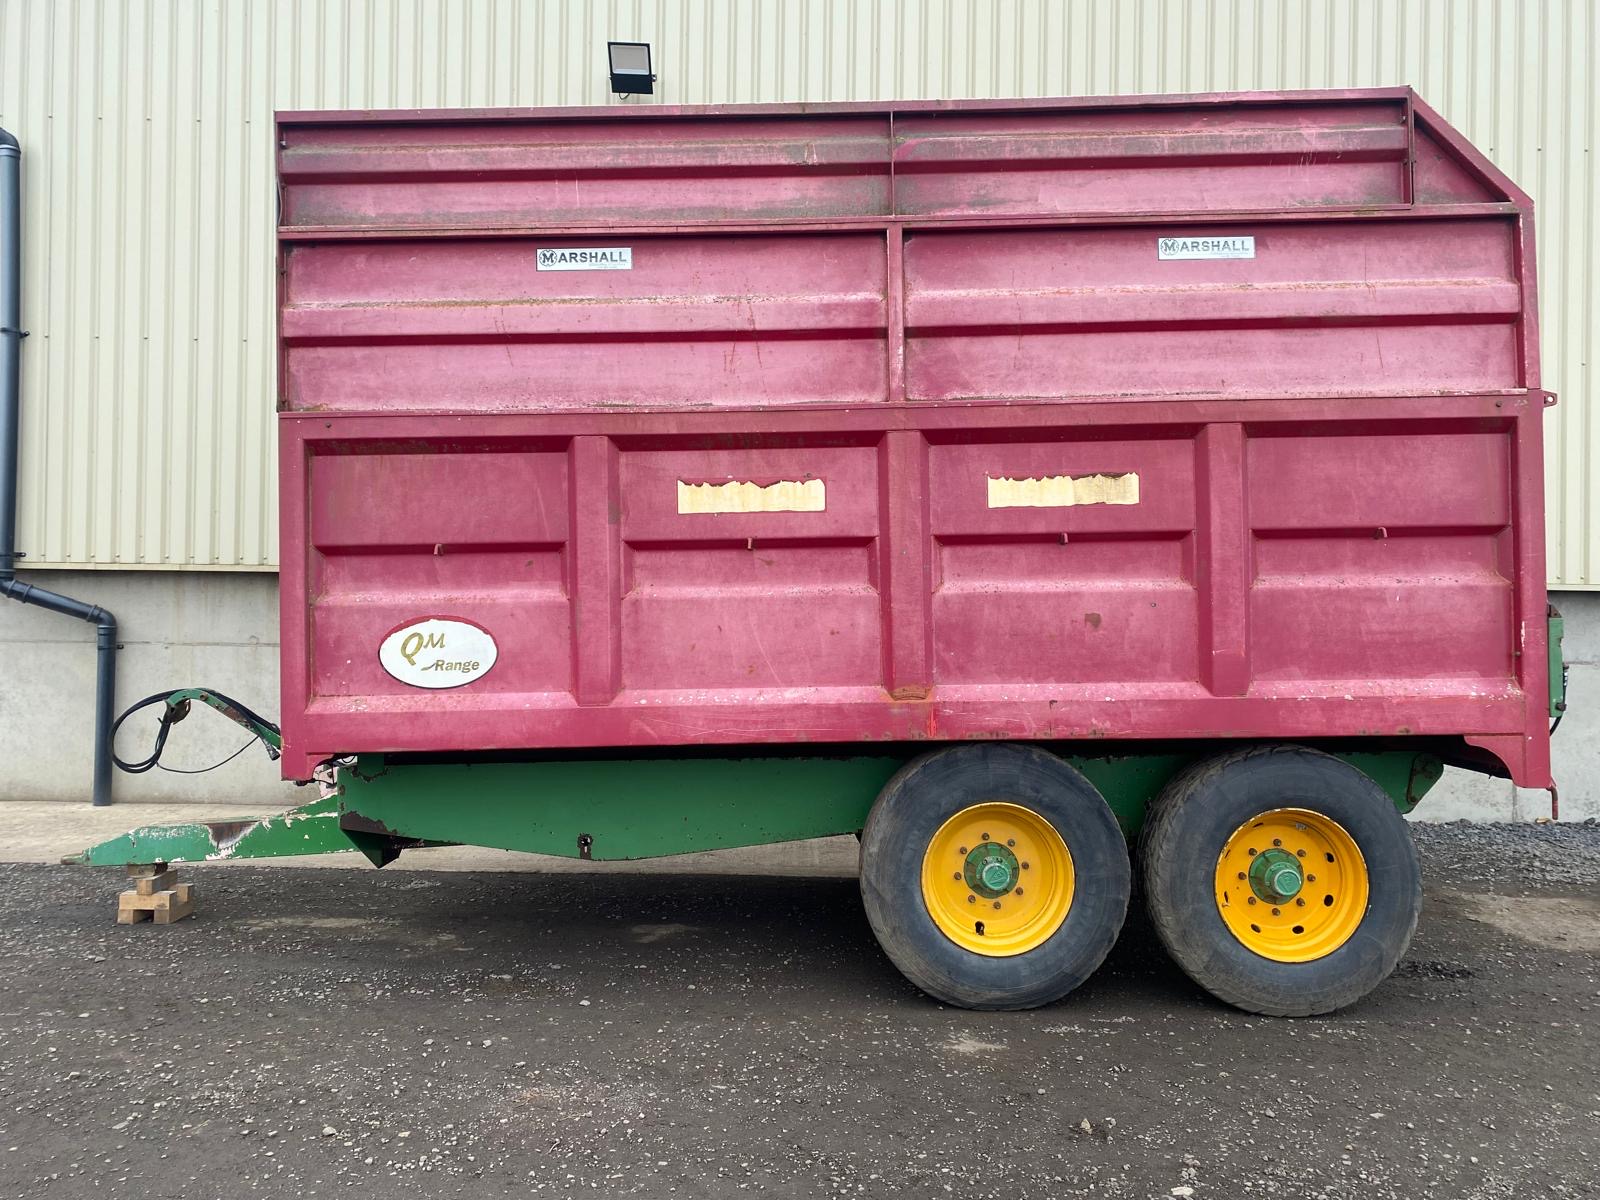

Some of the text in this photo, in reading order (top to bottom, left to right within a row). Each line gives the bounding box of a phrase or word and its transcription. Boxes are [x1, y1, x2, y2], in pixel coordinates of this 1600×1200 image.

[1160, 238, 1250, 256] MARSHALL
[538, 249, 627, 267] MARSHALL
[400, 632, 446, 666] QM
[434, 659, 480, 673] Range
